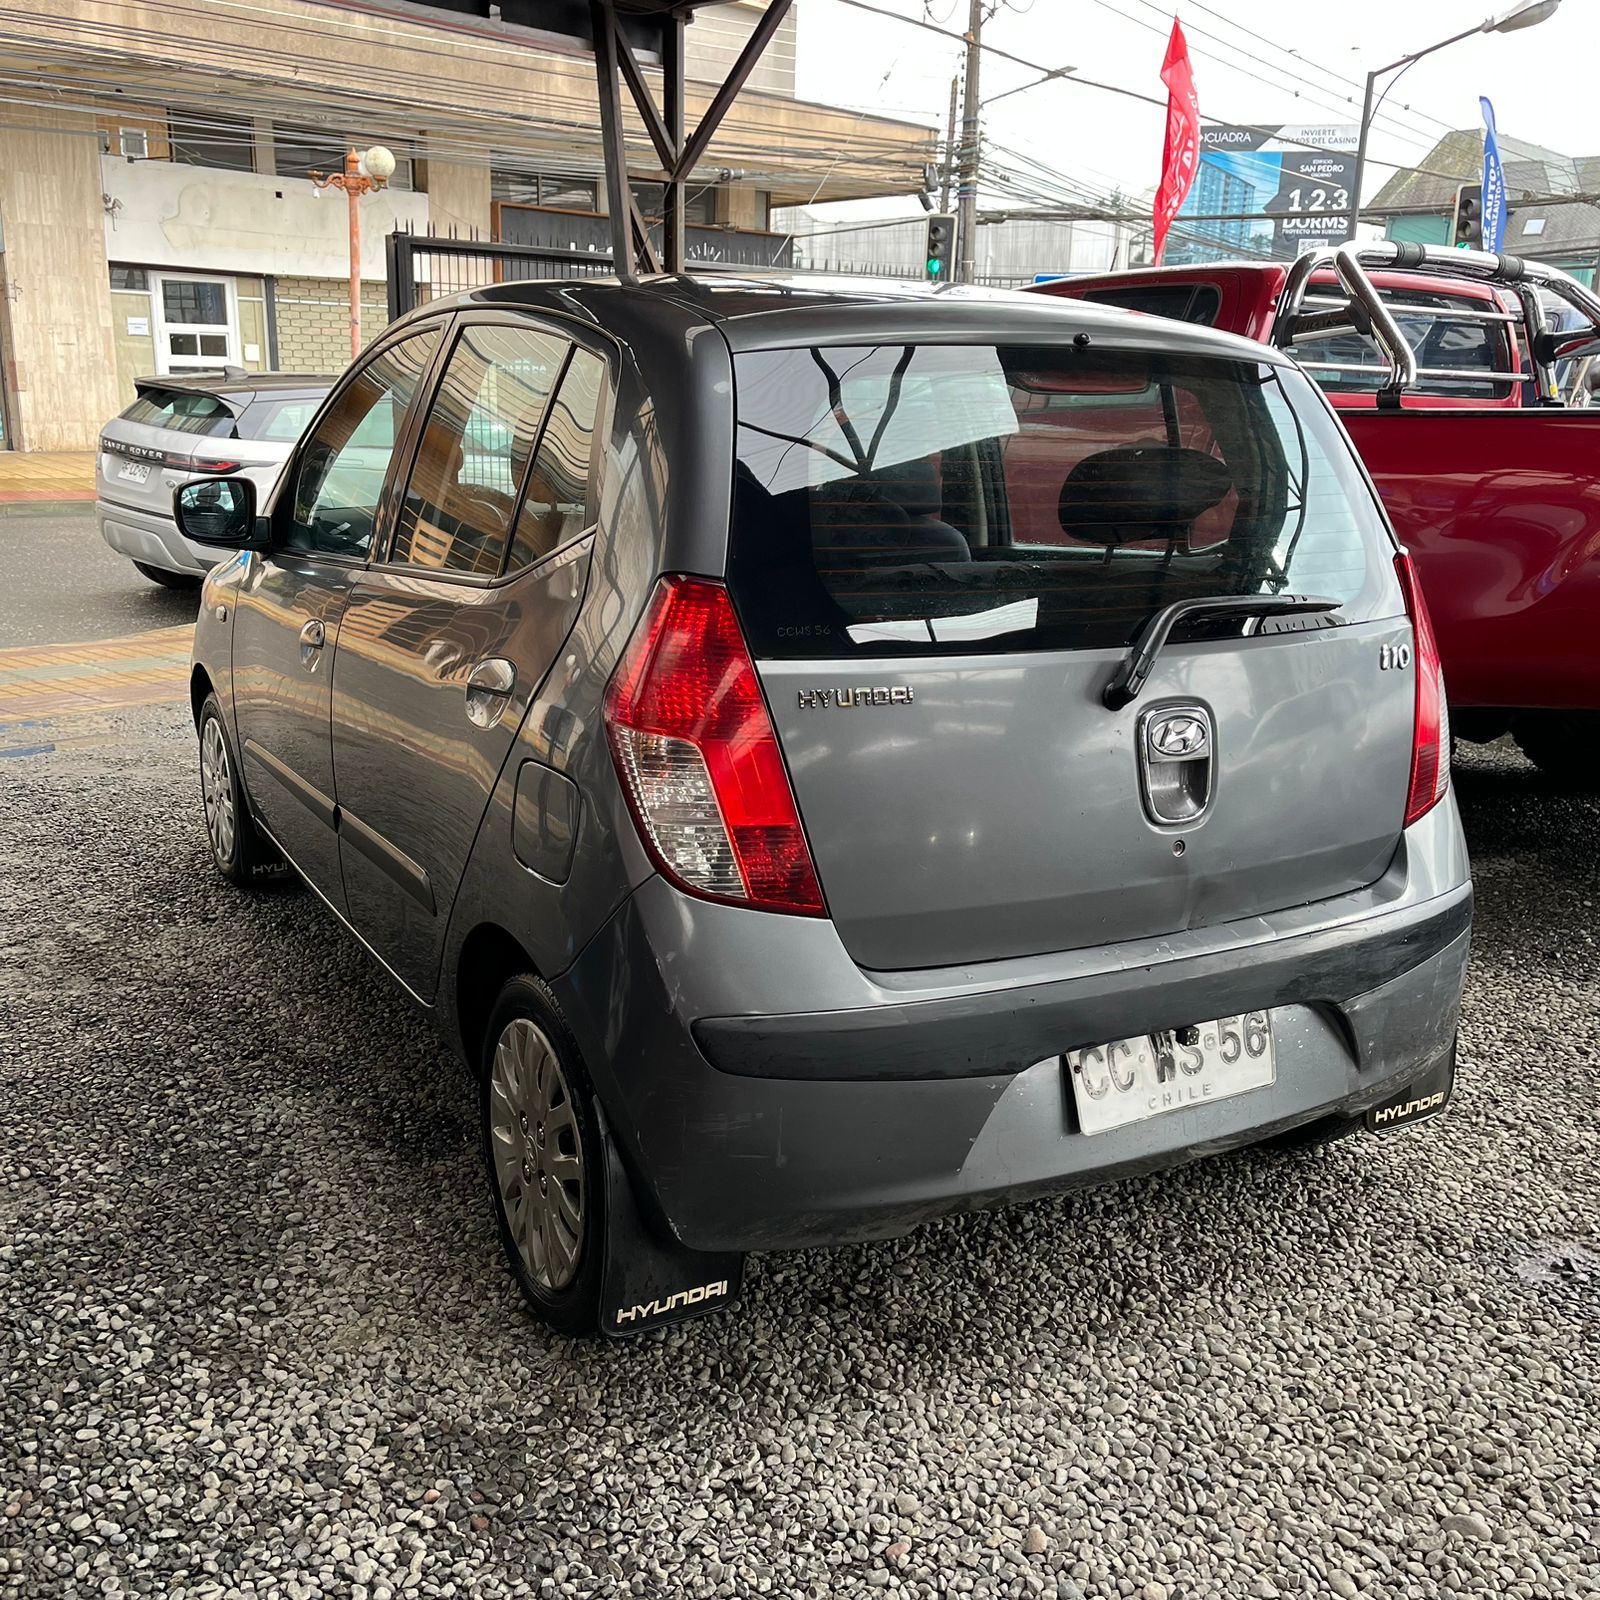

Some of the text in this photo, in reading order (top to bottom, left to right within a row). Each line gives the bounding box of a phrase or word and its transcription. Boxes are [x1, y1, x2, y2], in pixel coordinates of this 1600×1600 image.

[1317, 164, 1345, 172] PEDRO
[1282, 217, 1349, 228] DORMS
[129, 446, 164, 459] ROVER
[1380, 643, 1411, 671] i10
[798, 685, 914, 709] HYUNDAI
[1147, 1083, 1213, 1110] CHILE
[1374, 1091, 1445, 1123] HYUNDAI
[616, 1280, 728, 1324] HYUNDAI
